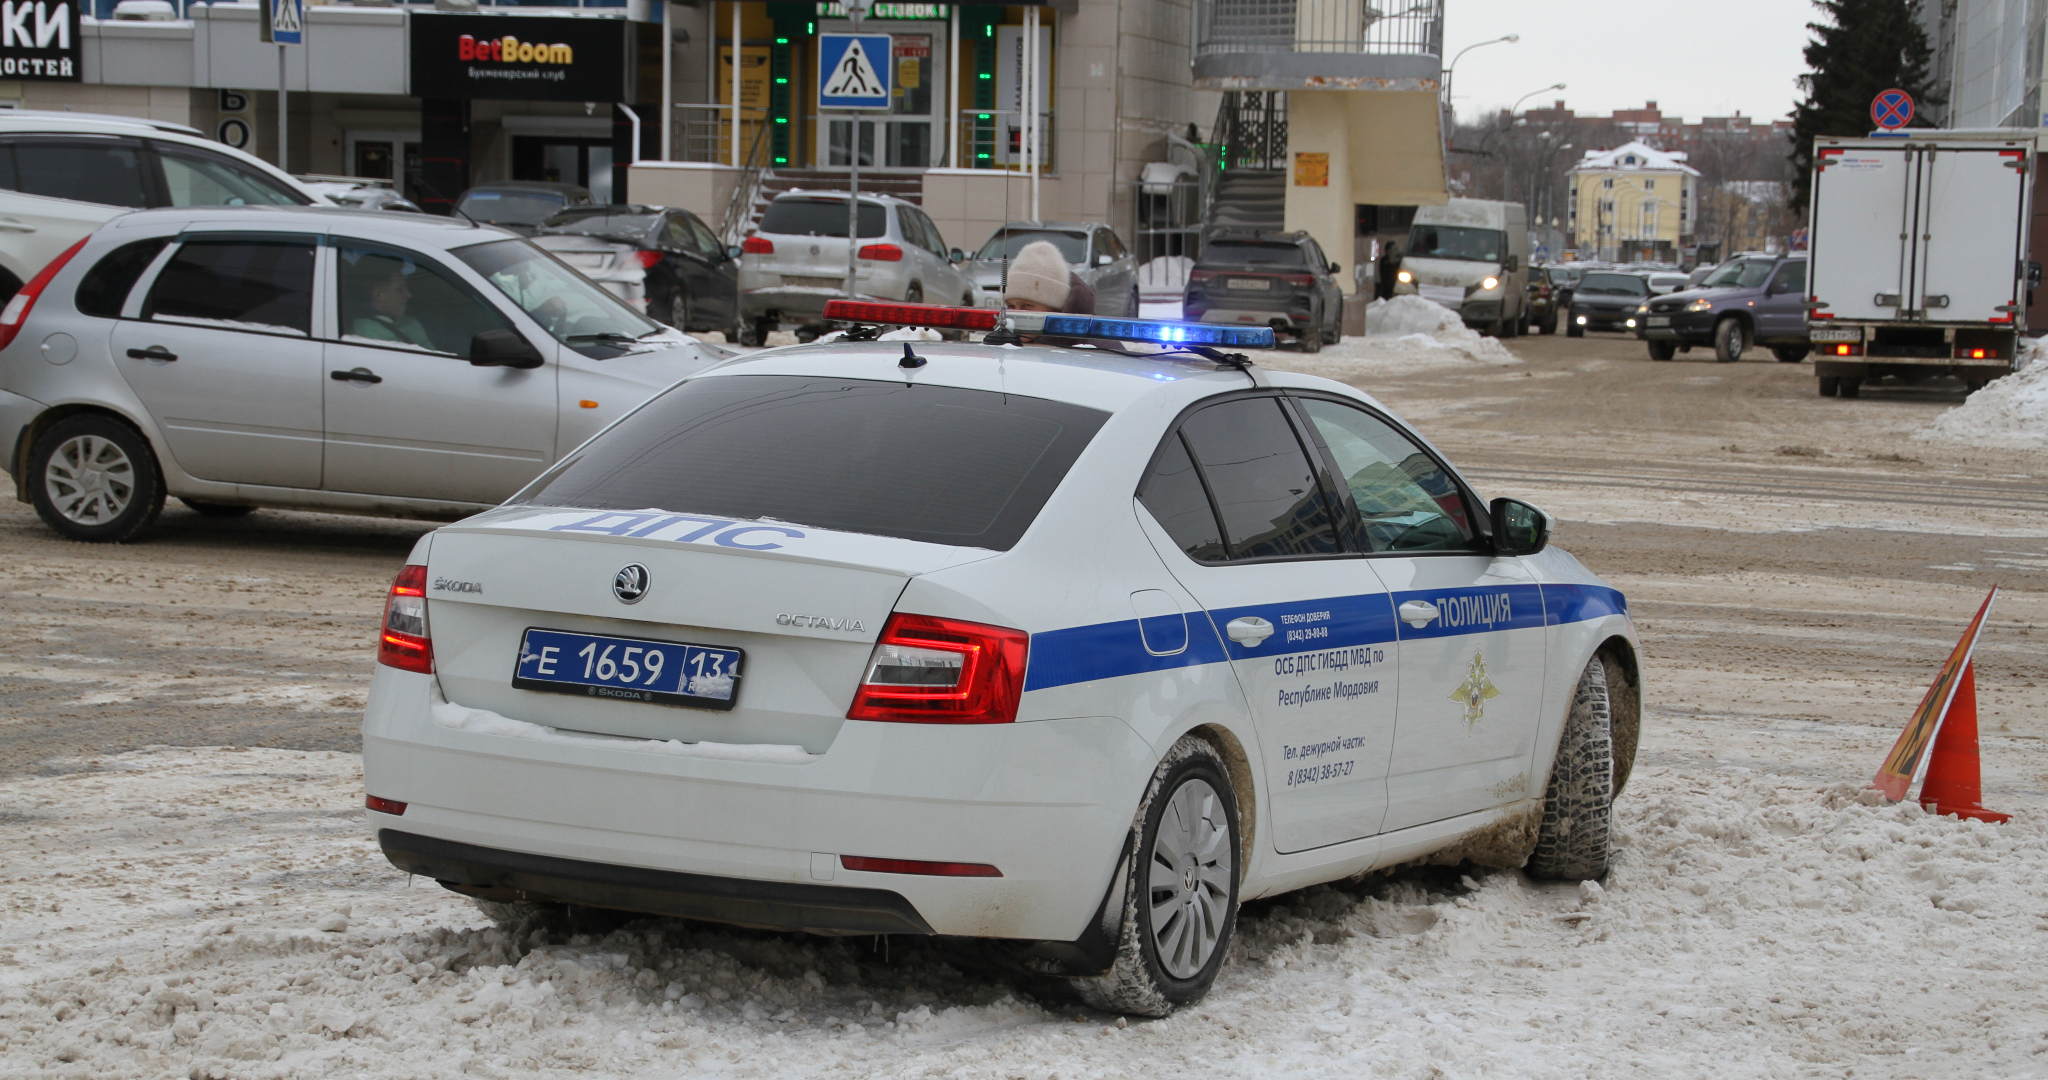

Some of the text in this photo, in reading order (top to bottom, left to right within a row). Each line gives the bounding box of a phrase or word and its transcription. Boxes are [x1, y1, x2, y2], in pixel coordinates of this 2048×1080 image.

[2, 0, 70, 49] КИ
[458, 34, 573, 64] BetBoom
[0, 57, 73, 76] ОСТЕЙ
[468, 66, 566, 82] Букмекерский клуб
[548, 511, 806, 551] ДПС
[432, 576, 483, 595] ŠKODA
[776, 612, 866, 633] OCTAVIA
[1280, 611, 1331, 625] ТЕЛЕФОН ДОВЕРИЯ
[1436, 593, 1512, 629] ПОЛИЦИЯ
[1286, 629, 1305, 644] (8342)
[578, 642, 665, 685] 1659
[690, 651, 725, 680] 13
[1275, 647, 1384, 677] ОСБ ДПС ГИБДД МВД по
[598, 688, 641, 700] ŠKODA
[1278, 680, 1379, 708] Республике Мордовия
[1283, 735, 1366, 761] Тел. дежурной части:
[1287, 760, 1354, 788] 8 (8342) 38-57-27
